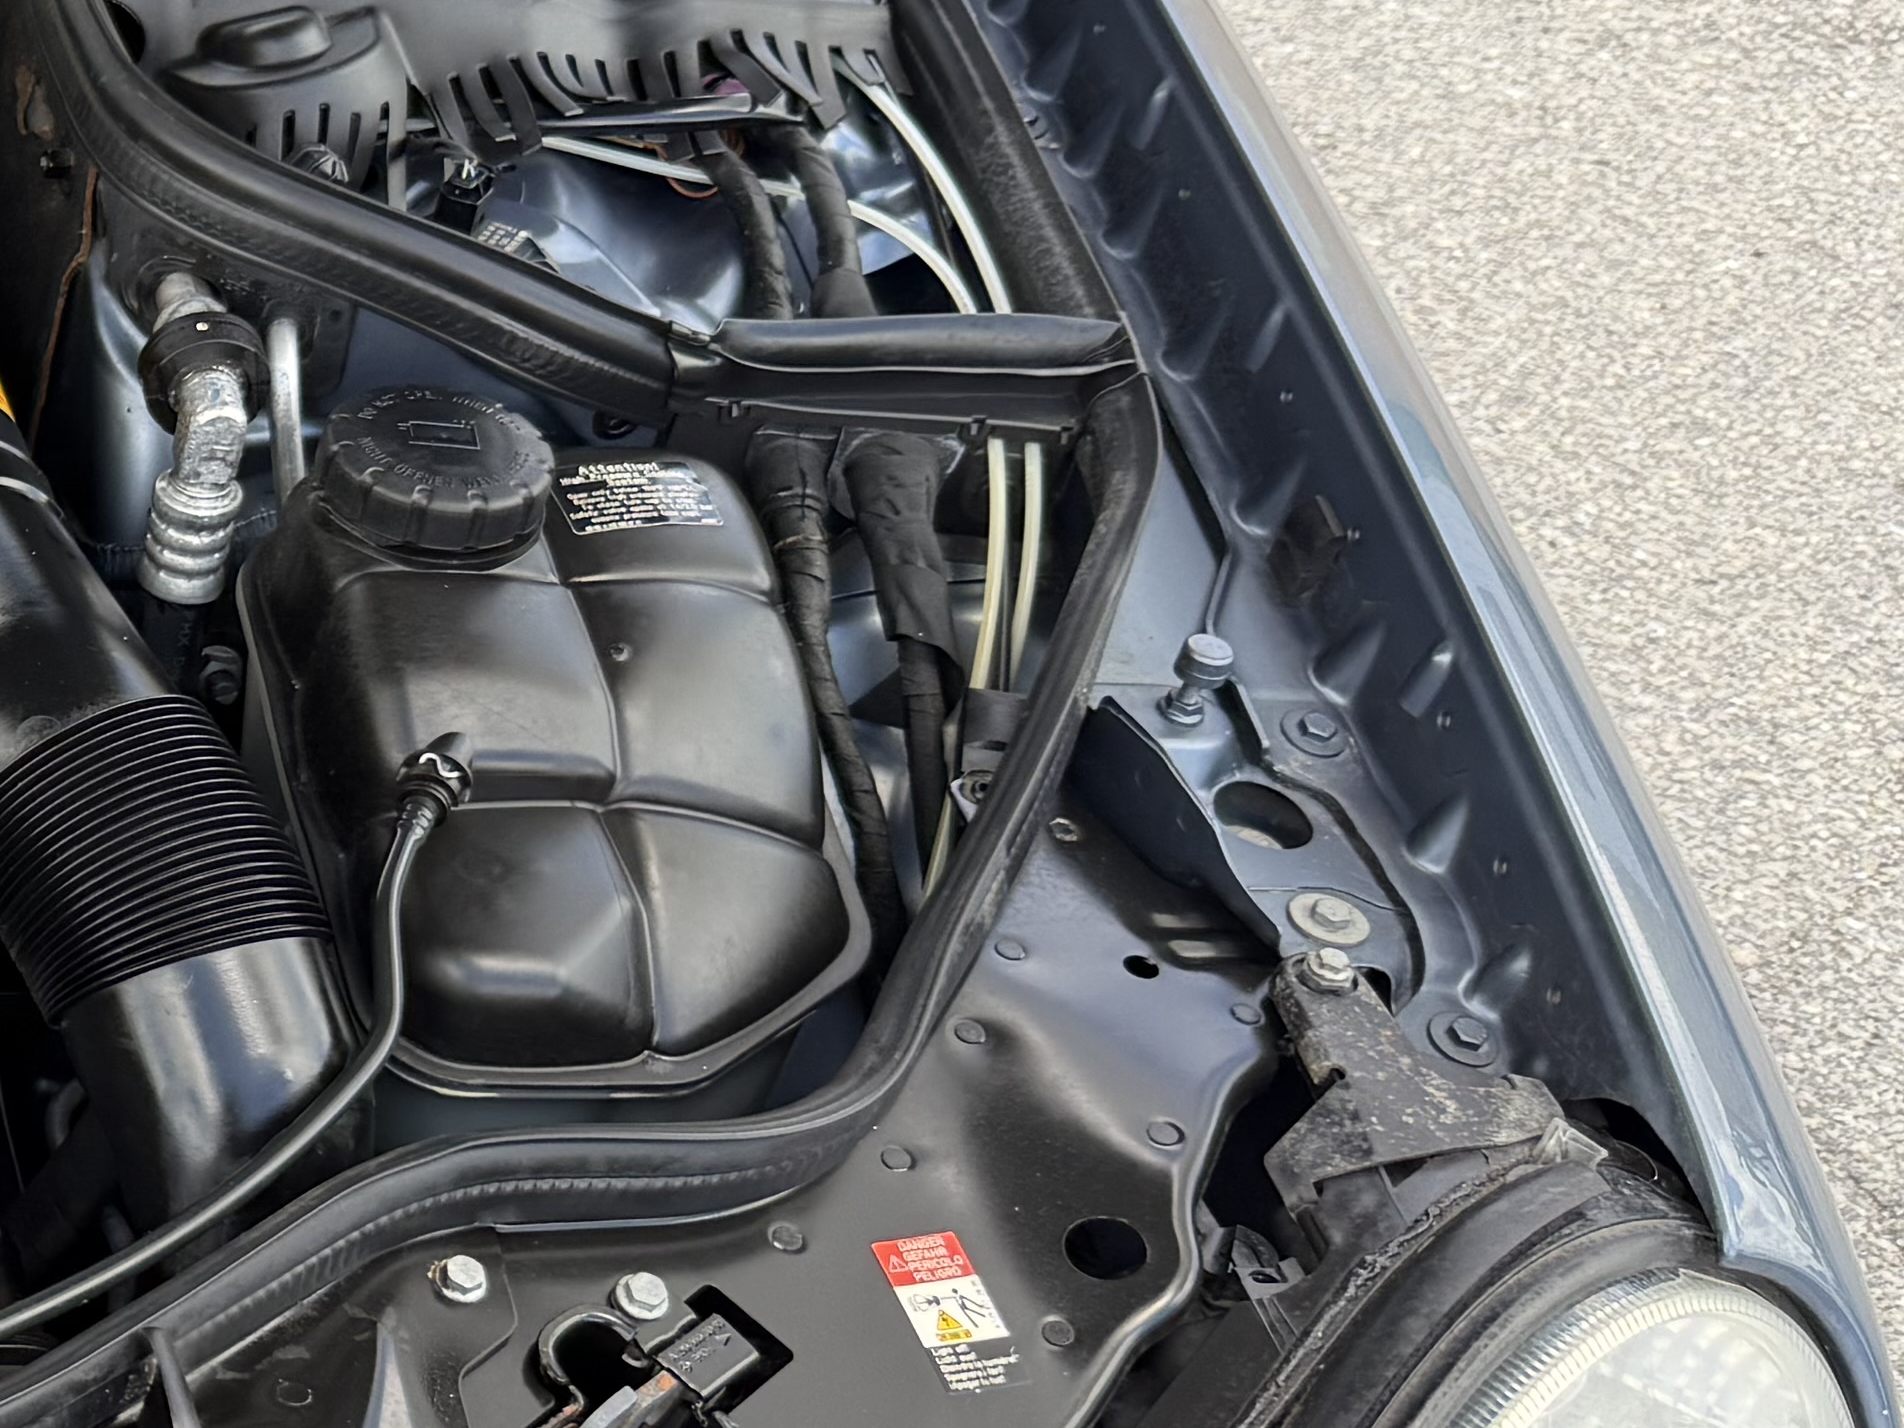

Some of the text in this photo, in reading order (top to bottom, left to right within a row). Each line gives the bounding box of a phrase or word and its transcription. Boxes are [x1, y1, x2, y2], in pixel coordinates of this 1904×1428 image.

[897, 1235, 946, 1251] DANGER
[902, 1246, 949, 1262] GEFAHR
[907, 1255, 964, 1272] PERICOLO
[913, 1266, 962, 1282] PELIGRO
